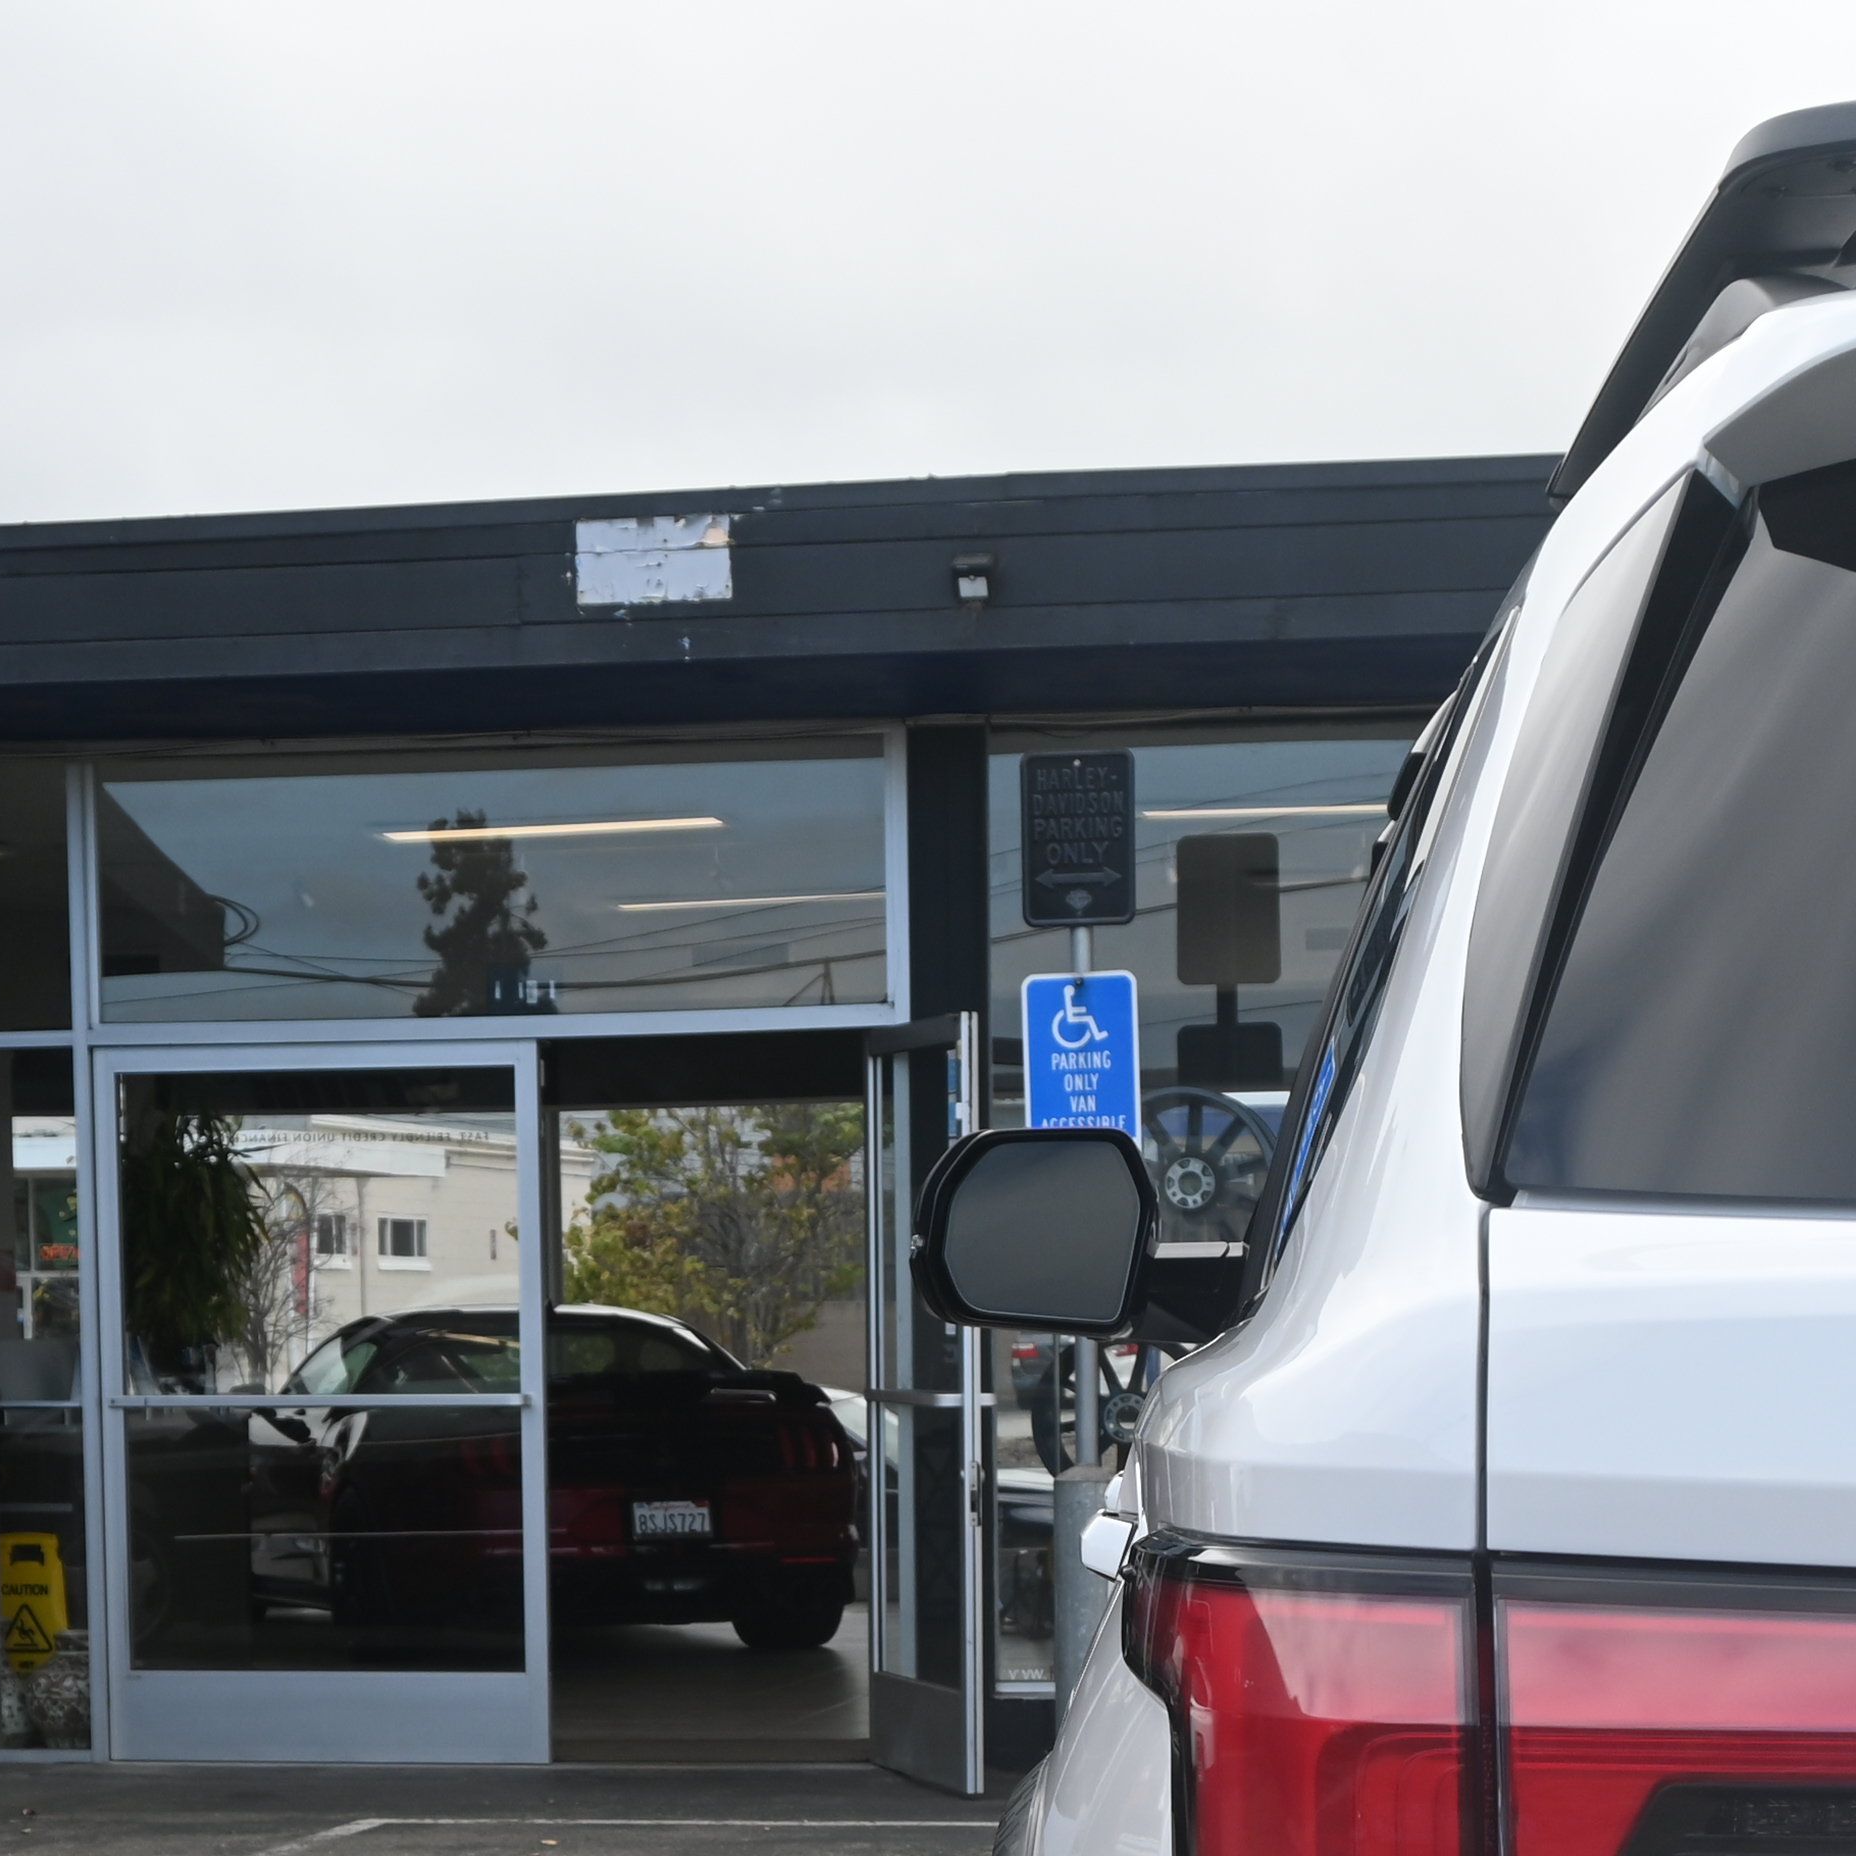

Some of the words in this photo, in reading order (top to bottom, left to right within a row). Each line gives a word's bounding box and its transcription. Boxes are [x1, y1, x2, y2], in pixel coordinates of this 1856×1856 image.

[1035, 766, 1118, 790] HARLEY-
[1032, 791, 1125, 815] DAVIDSON
[1033, 816, 1124, 839] PARKING
[1046, 841, 1110, 864] ONLY
[1051, 1050, 1112, 1071] PARKING
[1064, 1073, 1099, 1092] ONLY
[1069, 1095, 1097, 1113] VAN
[1, 1584, 49, 1595] CAUTION
